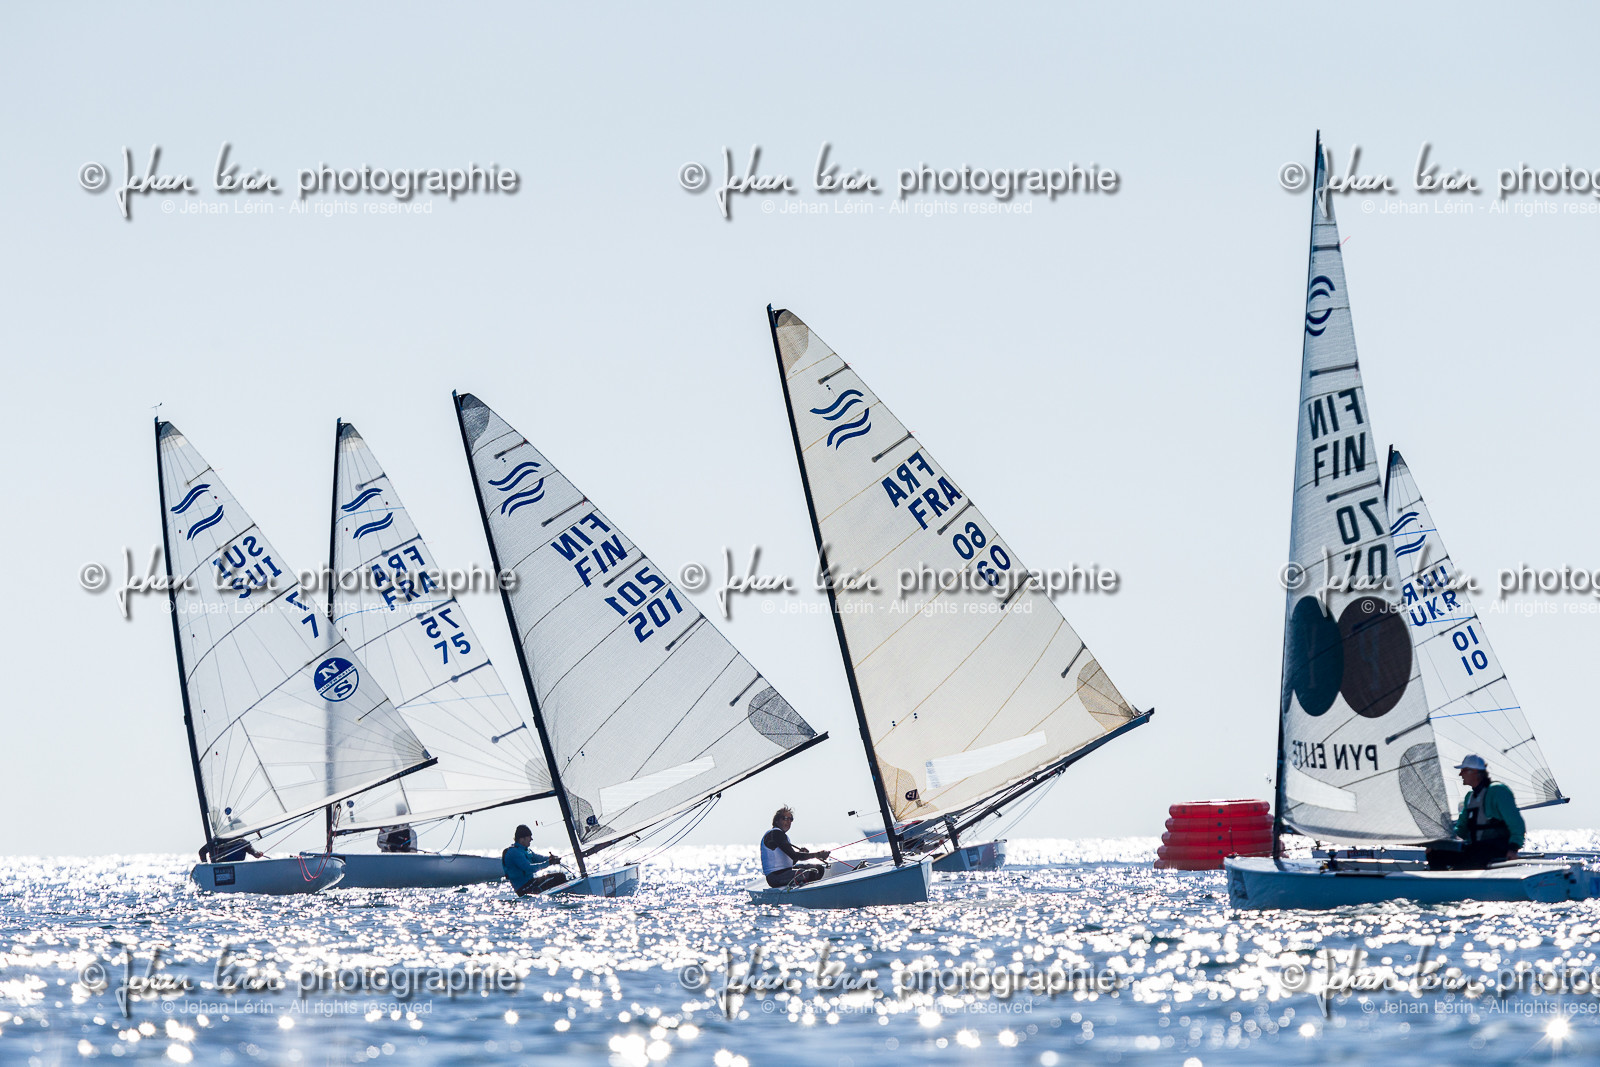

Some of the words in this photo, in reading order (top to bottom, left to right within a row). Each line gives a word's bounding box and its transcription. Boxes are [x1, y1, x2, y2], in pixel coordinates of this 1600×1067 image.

[1314, 431, 1366, 487] FIN
[907, 476, 962, 531] FRA
[232, 555, 282, 599] SUI
[574, 534, 628, 588] FIN
[976, 544, 1011, 587] 60
[1344, 543, 1389, 593] 70
[381, 571, 438, 611] FRA
[1409, 589, 1461, 627] UKR
[301, 613, 319, 639] 7
[627, 588, 683, 643] 201
[433, 631, 471, 665] 75
[1461, 649, 1488, 676] 10
[318, 661, 339, 681] N
[334, 679, 353, 698] S
